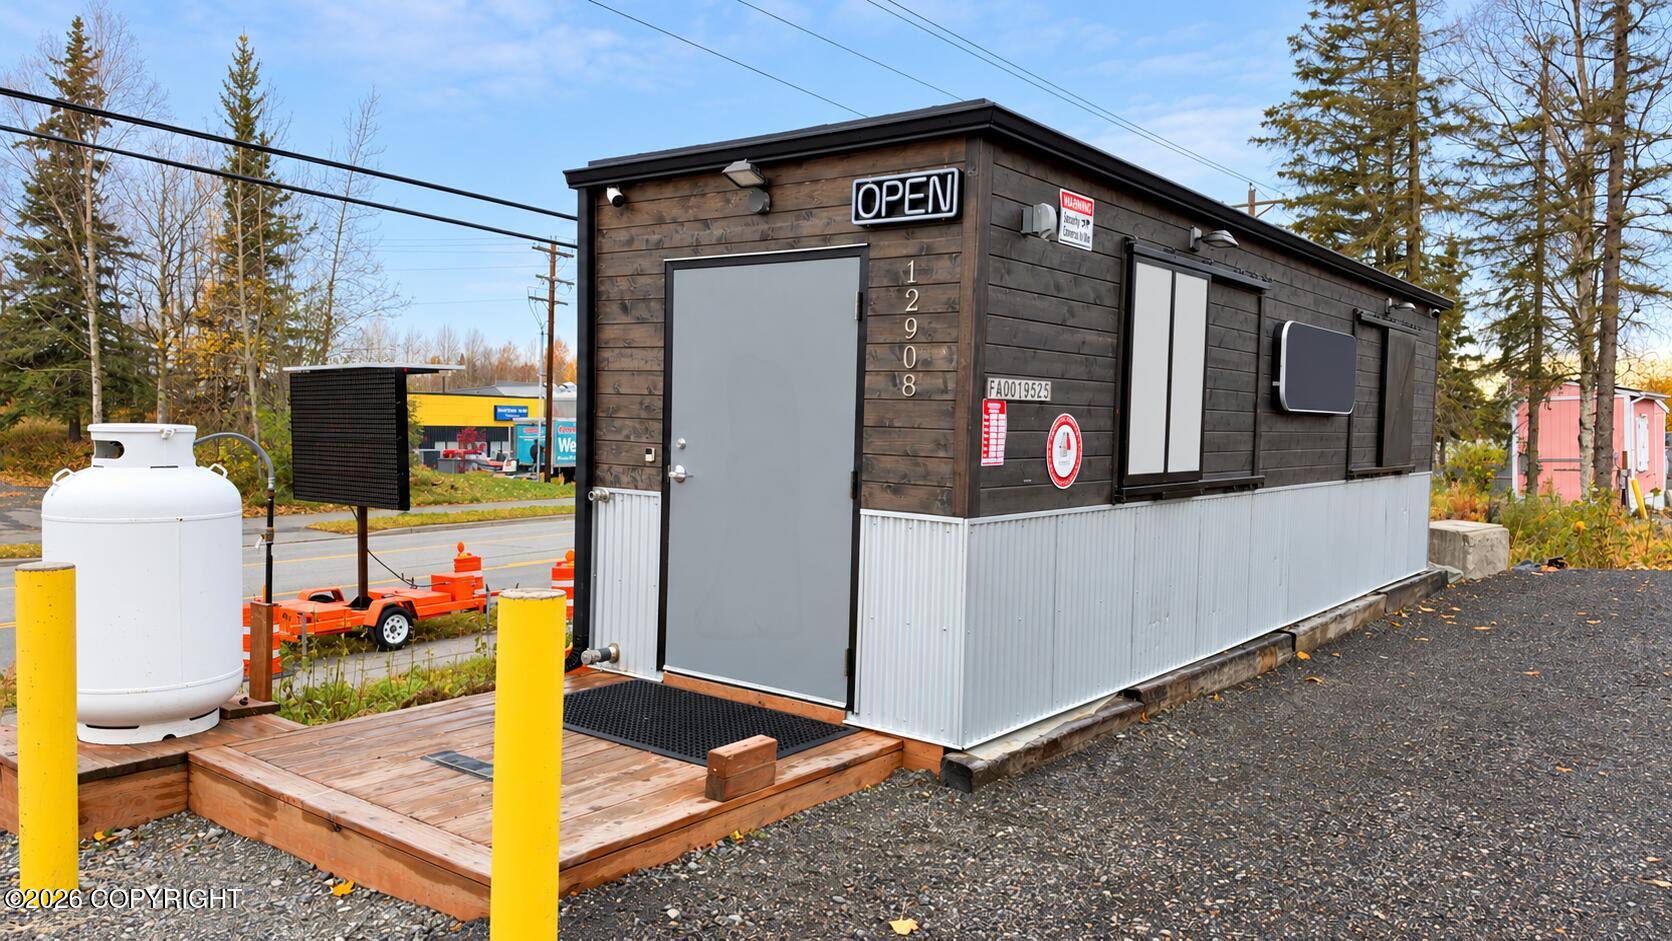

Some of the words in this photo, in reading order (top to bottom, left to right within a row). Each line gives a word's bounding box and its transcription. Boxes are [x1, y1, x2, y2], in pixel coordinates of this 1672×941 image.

[858, 174, 952, 218] OPEN
[902, 259, 919, 397] 12908
[990, 380, 1049, 399] FA0019525
